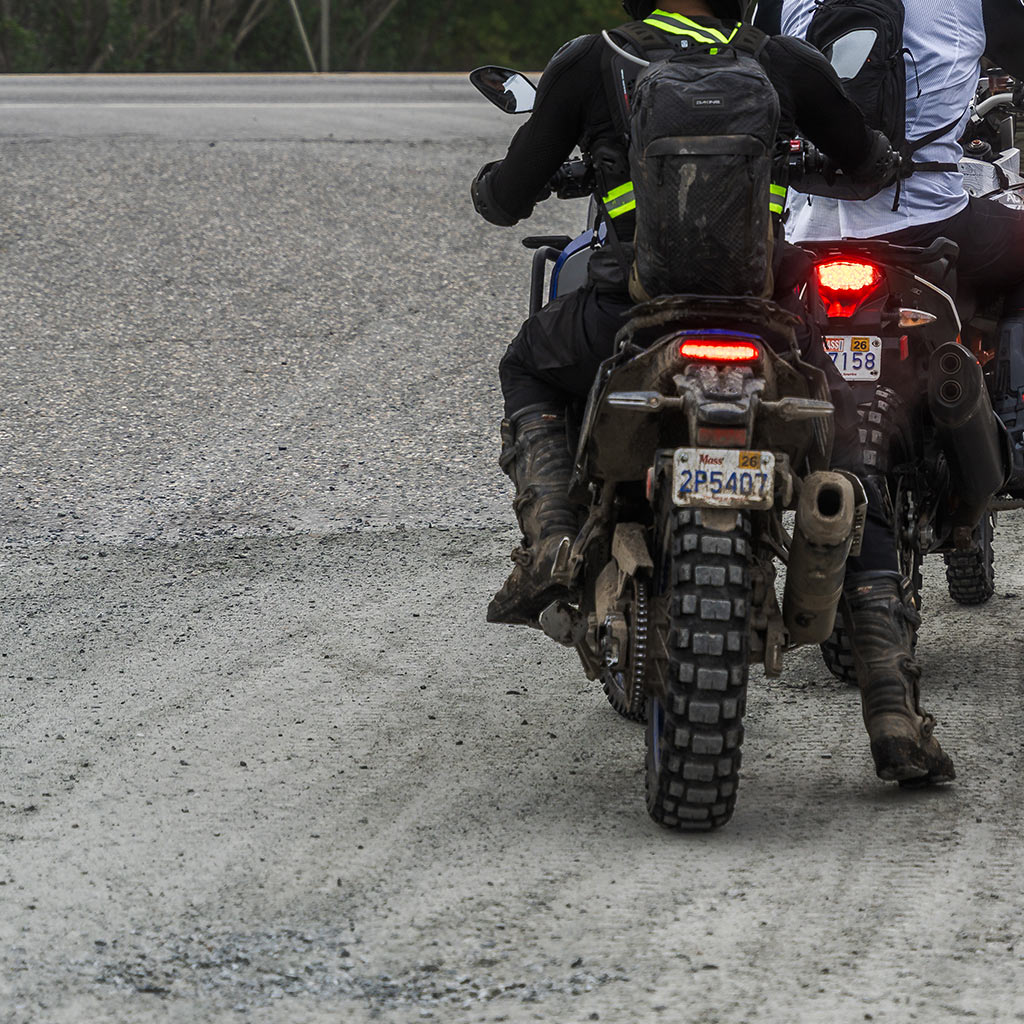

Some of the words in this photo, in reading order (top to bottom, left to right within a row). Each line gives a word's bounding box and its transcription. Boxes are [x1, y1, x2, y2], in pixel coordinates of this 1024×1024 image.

[853, 340, 868, 350] 26
[742, 456, 757, 467] 26
[680, 470, 768, 494] 2P5407
